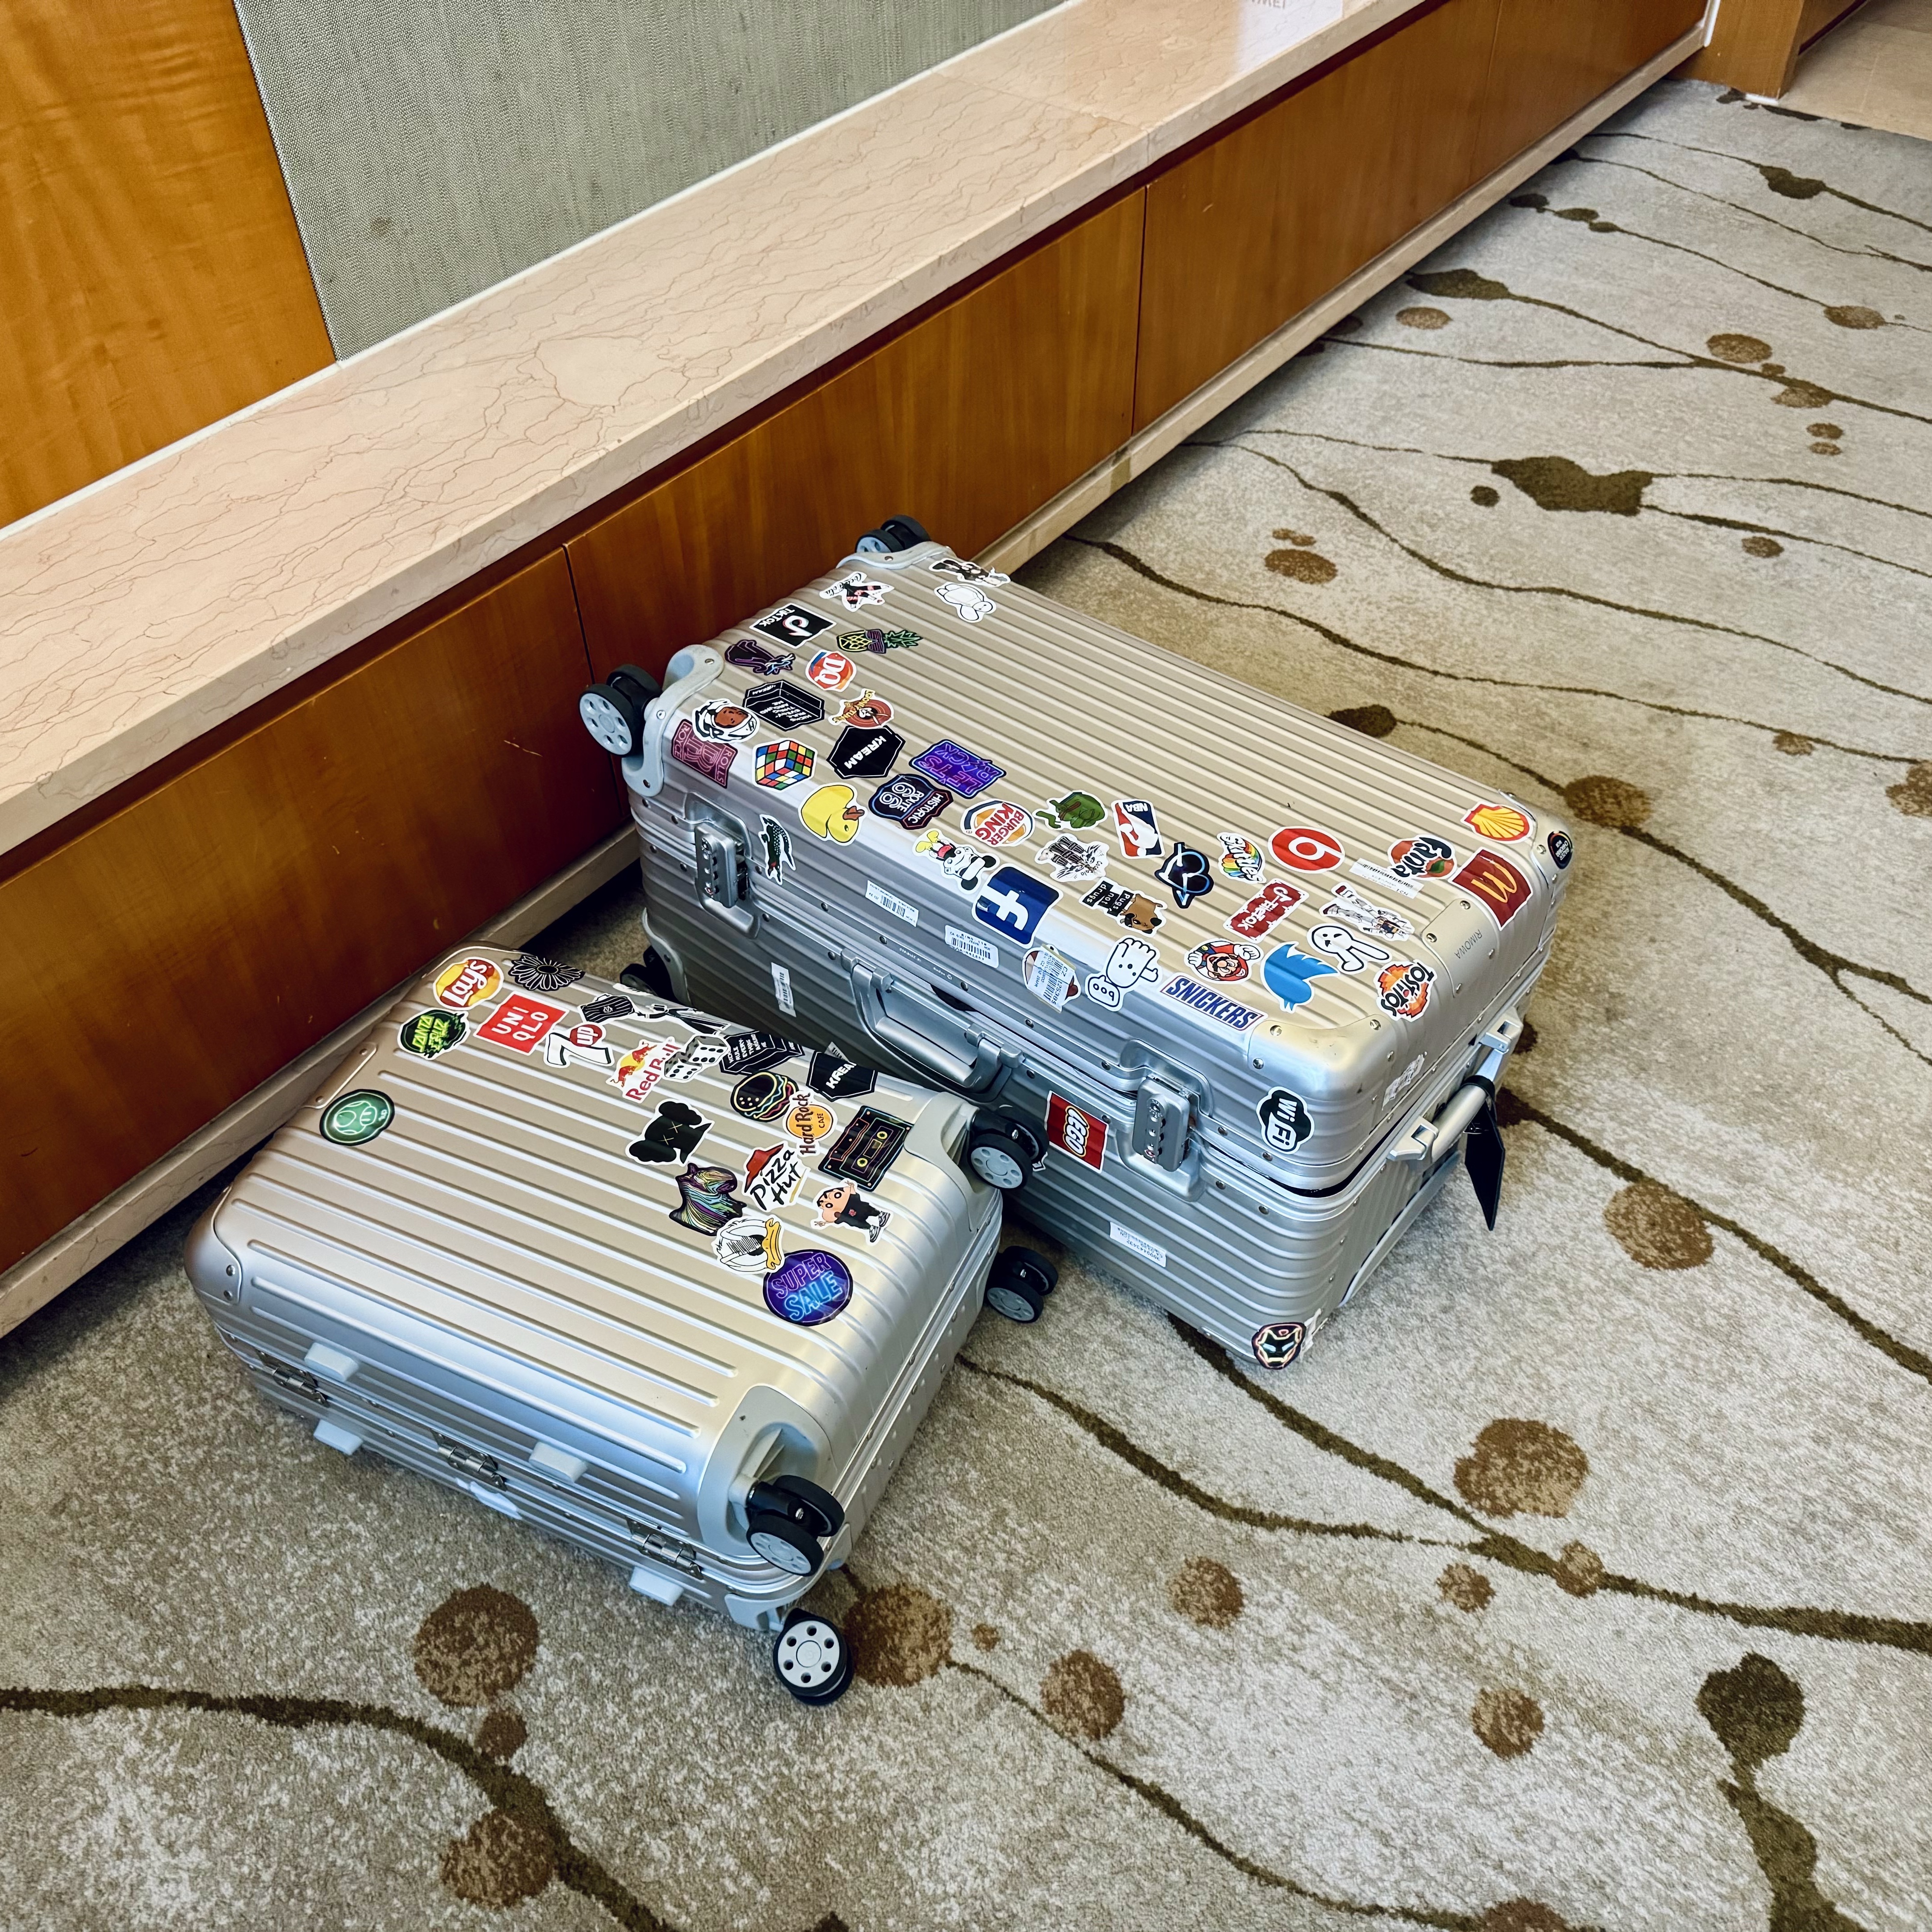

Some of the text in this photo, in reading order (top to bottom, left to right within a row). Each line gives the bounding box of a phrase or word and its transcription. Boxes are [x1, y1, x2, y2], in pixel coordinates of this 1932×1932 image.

[759, 608, 795, 627] TikTok
[814, 657, 846, 685] DQ
[675, 724, 690, 759] ROYCE
[844, 736, 887, 769] KREAM
[717, 749, 733, 783] ROLLS
[879, 782, 916, 808] 66
[897, 791, 925, 812] ROUTE
[908, 793, 943, 823] HISTORIC
[1125, 802, 1149, 812] NBA
[975, 803, 1014, 840] KING
[987, 810, 1024, 845] BURGER
[1390, 837, 1453, 878] Fanta
[1086, 883, 1107, 903] drugs
[1102, 892, 1114, 905] not
[1109, 893, 1131, 911] Pugs,
[1454, 929, 1482, 960] RIMOWA
[442, 960, 487, 1006] Lay's
[1169, 978, 1256, 1028] SNICKERS
[412, 1015, 433, 1053] SANTA
[492, 1006, 529, 1034] UNI
[513, 1011, 549, 1040] QLO
[576, 1026, 598, 1046] up
[626, 1044, 681, 1100] Red Bll
[792, 1092, 817, 1155] Hard Rock
[817, 1113, 825, 1128] CAFE
[1065, 1108, 1087, 1155] LEGO
[750, 1147, 795, 1210] Pizza
[773, 1160, 800, 1205] Hut
[772, 1252, 828, 1299] SUPER
[784, 1271, 842, 1321] SALE
